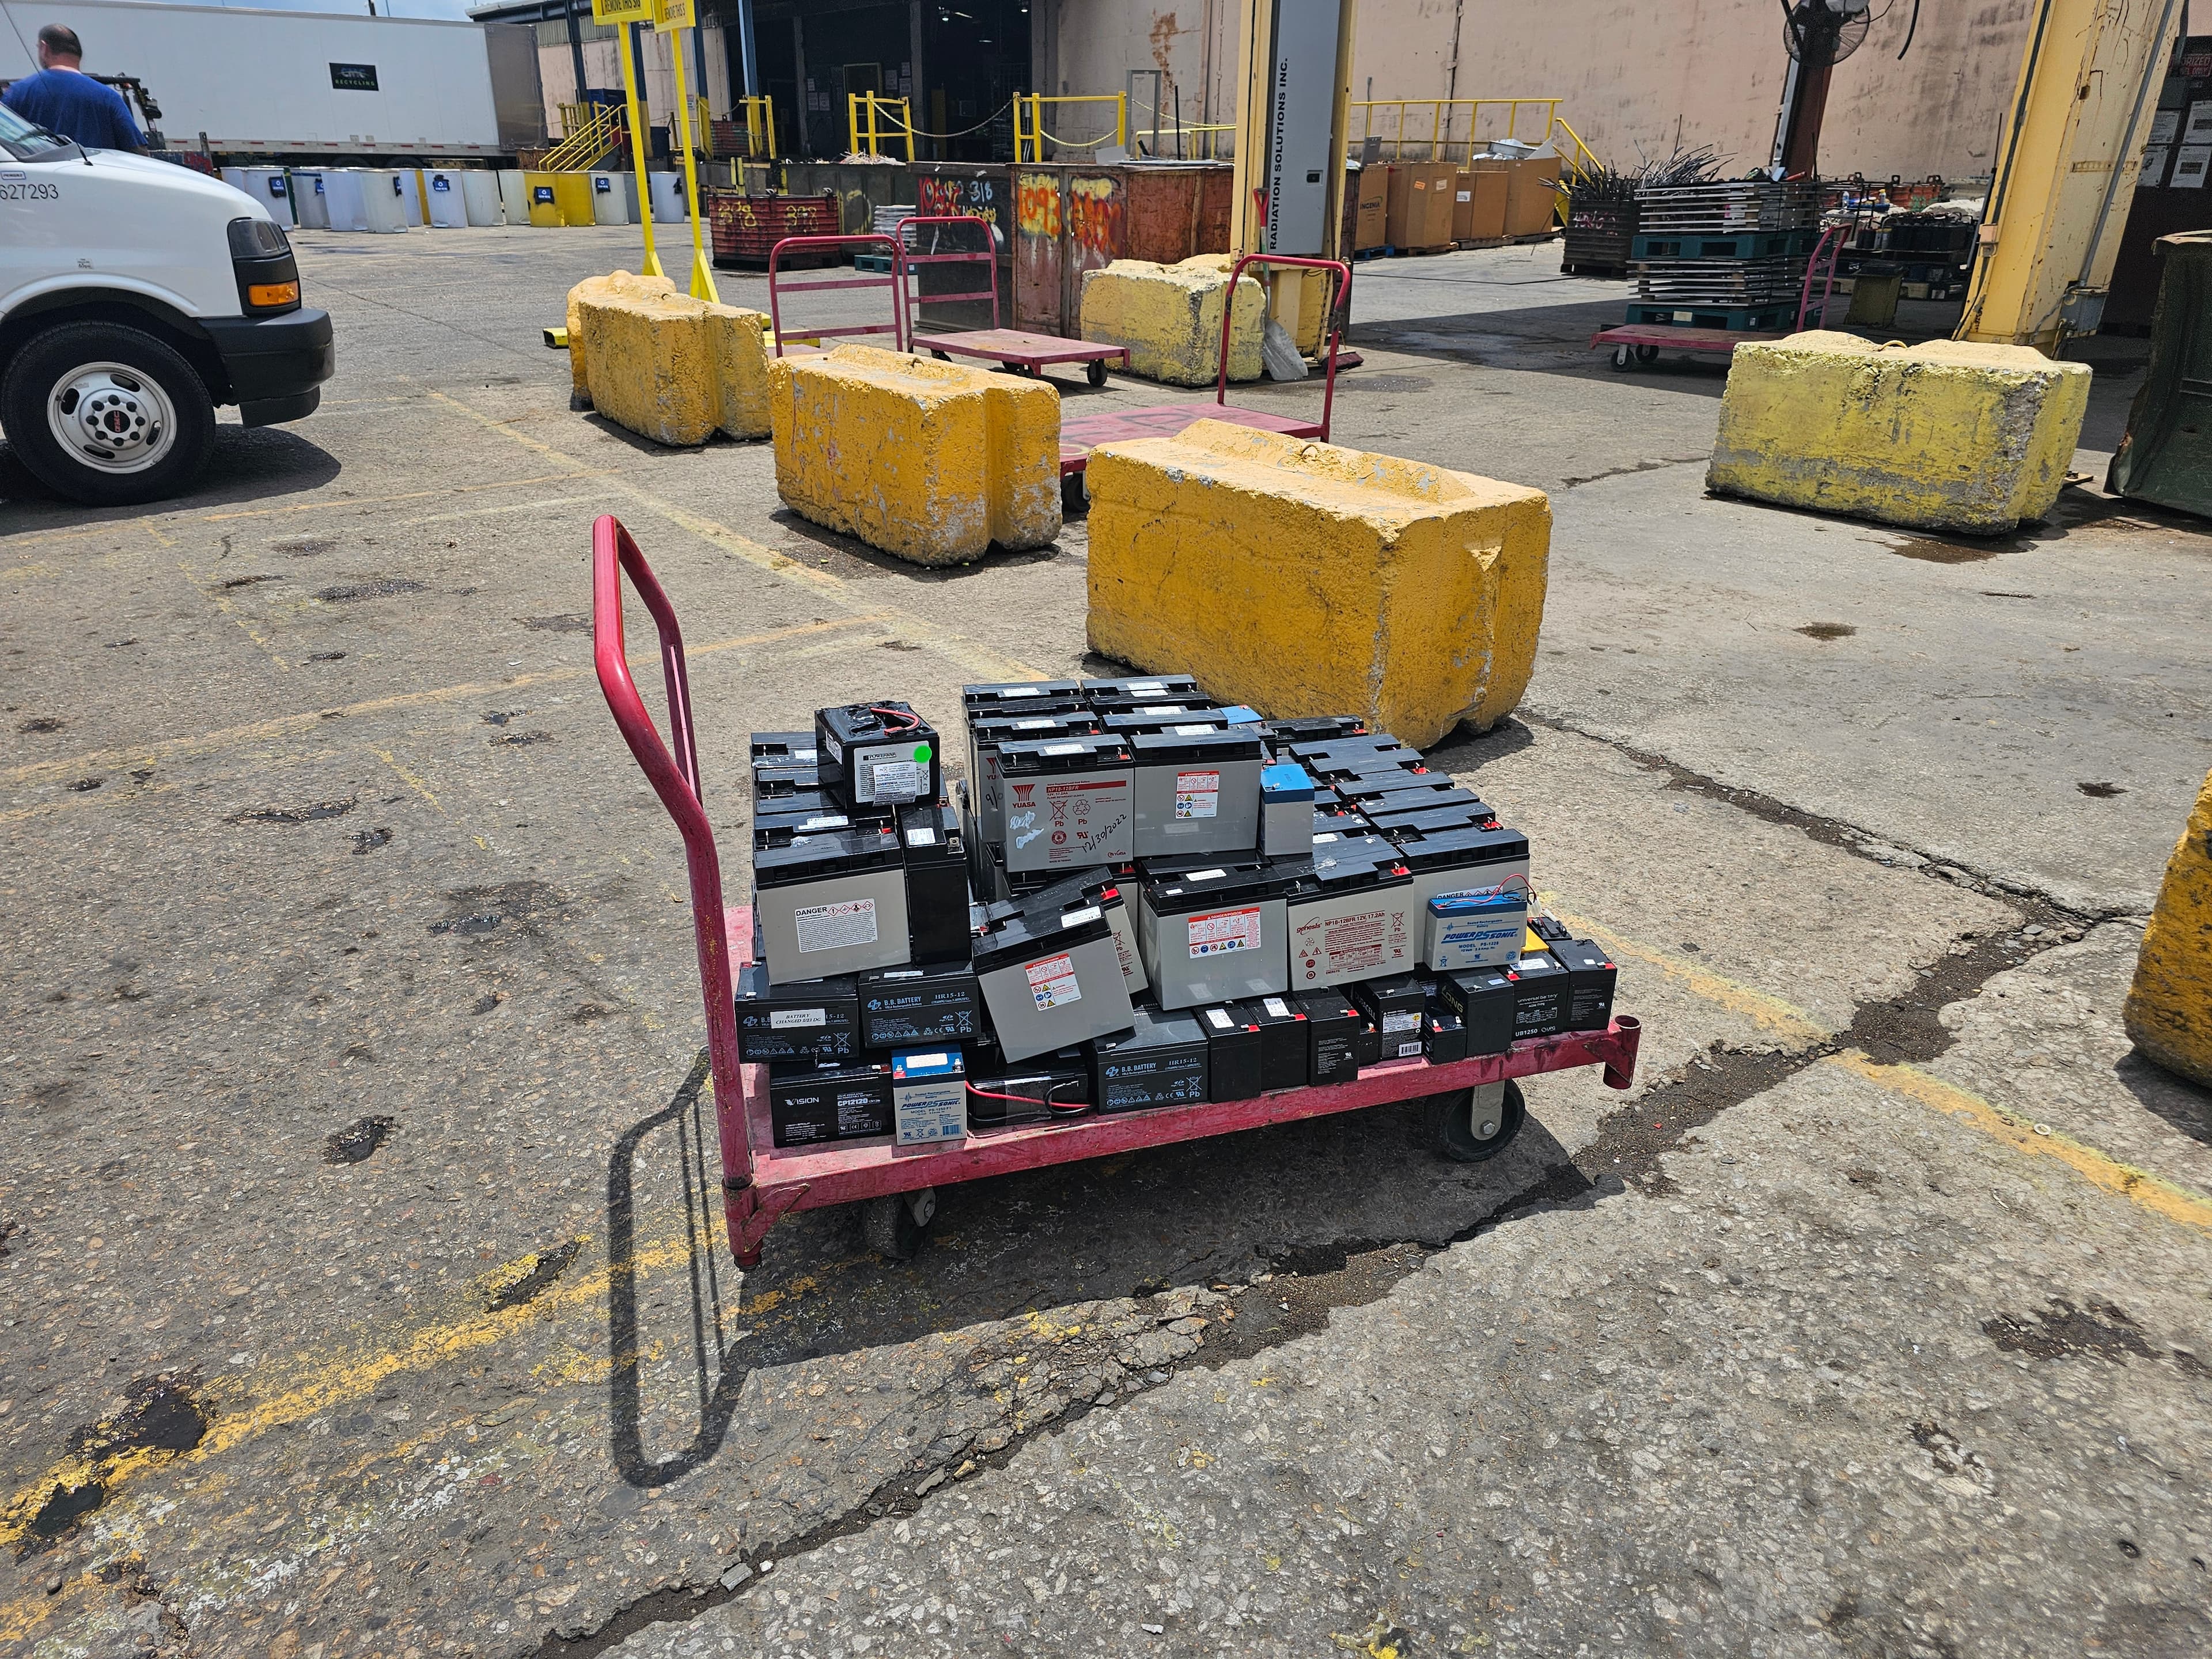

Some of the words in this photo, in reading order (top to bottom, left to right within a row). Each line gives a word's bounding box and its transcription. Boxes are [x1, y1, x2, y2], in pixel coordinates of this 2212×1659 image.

[1279, 57, 1287, 87] INC.
[1274, 92, 1286, 172] SOLUTIONS
[0, 184, 59, 199] 627293
[1270, 177, 1281, 249] RADIATION
[1082, 814, 1127, 853] 12/30/2022
[796, 907, 827, 916] DANGER
[1297, 923, 1321, 934] genesis
[1443, 932, 1476, 941] POWER
[1489, 931, 1516, 940] SONIC
[897, 996, 921, 1004] BATTERY
[935, 991, 965, 999] HR15-12
[1442, 986, 1464, 1013] LONG
[1515, 1028, 1538, 1036] UB1250
[1134, 1062, 1156, 1071] BATTERY
[1169, 1058, 1197, 1066] HR15-12
[785, 1097, 819, 1106] VISION
